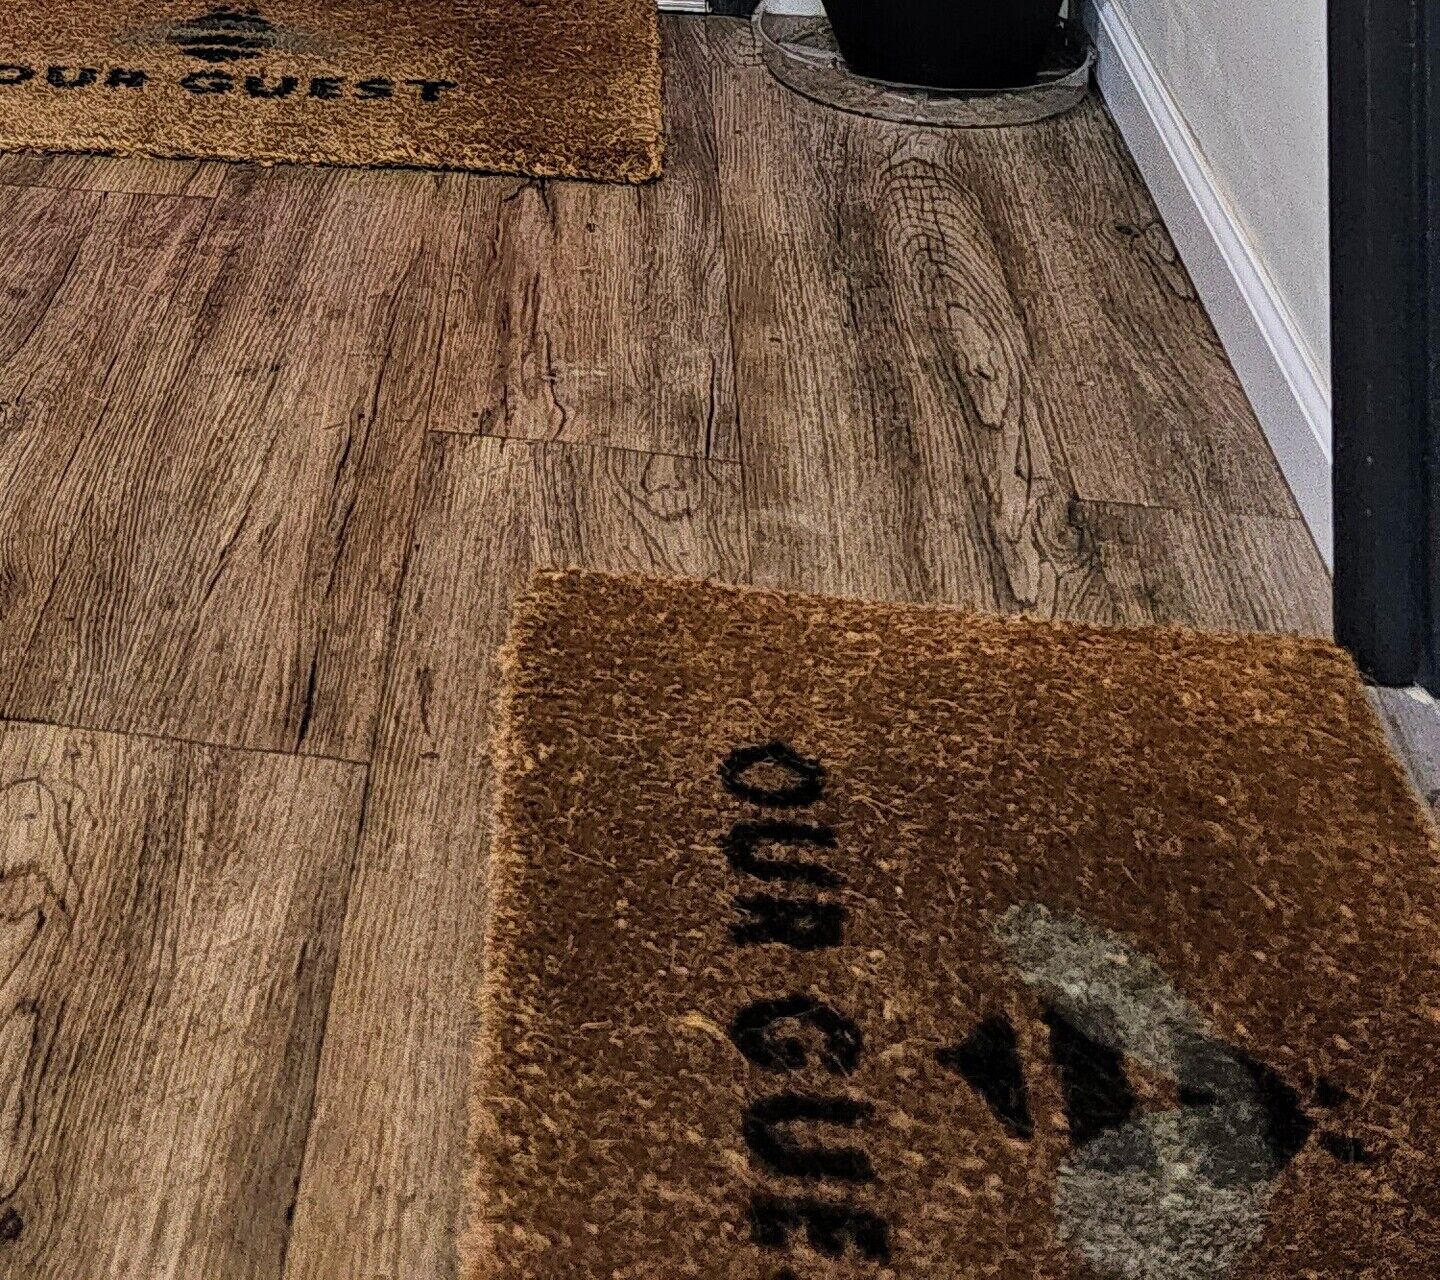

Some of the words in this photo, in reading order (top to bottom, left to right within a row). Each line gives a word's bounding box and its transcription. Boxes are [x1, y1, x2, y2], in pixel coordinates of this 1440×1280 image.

[178, 71, 459, 101] GUEST
[719, 741, 844, 948] OUR
[730, 996, 890, 1280] GUE
